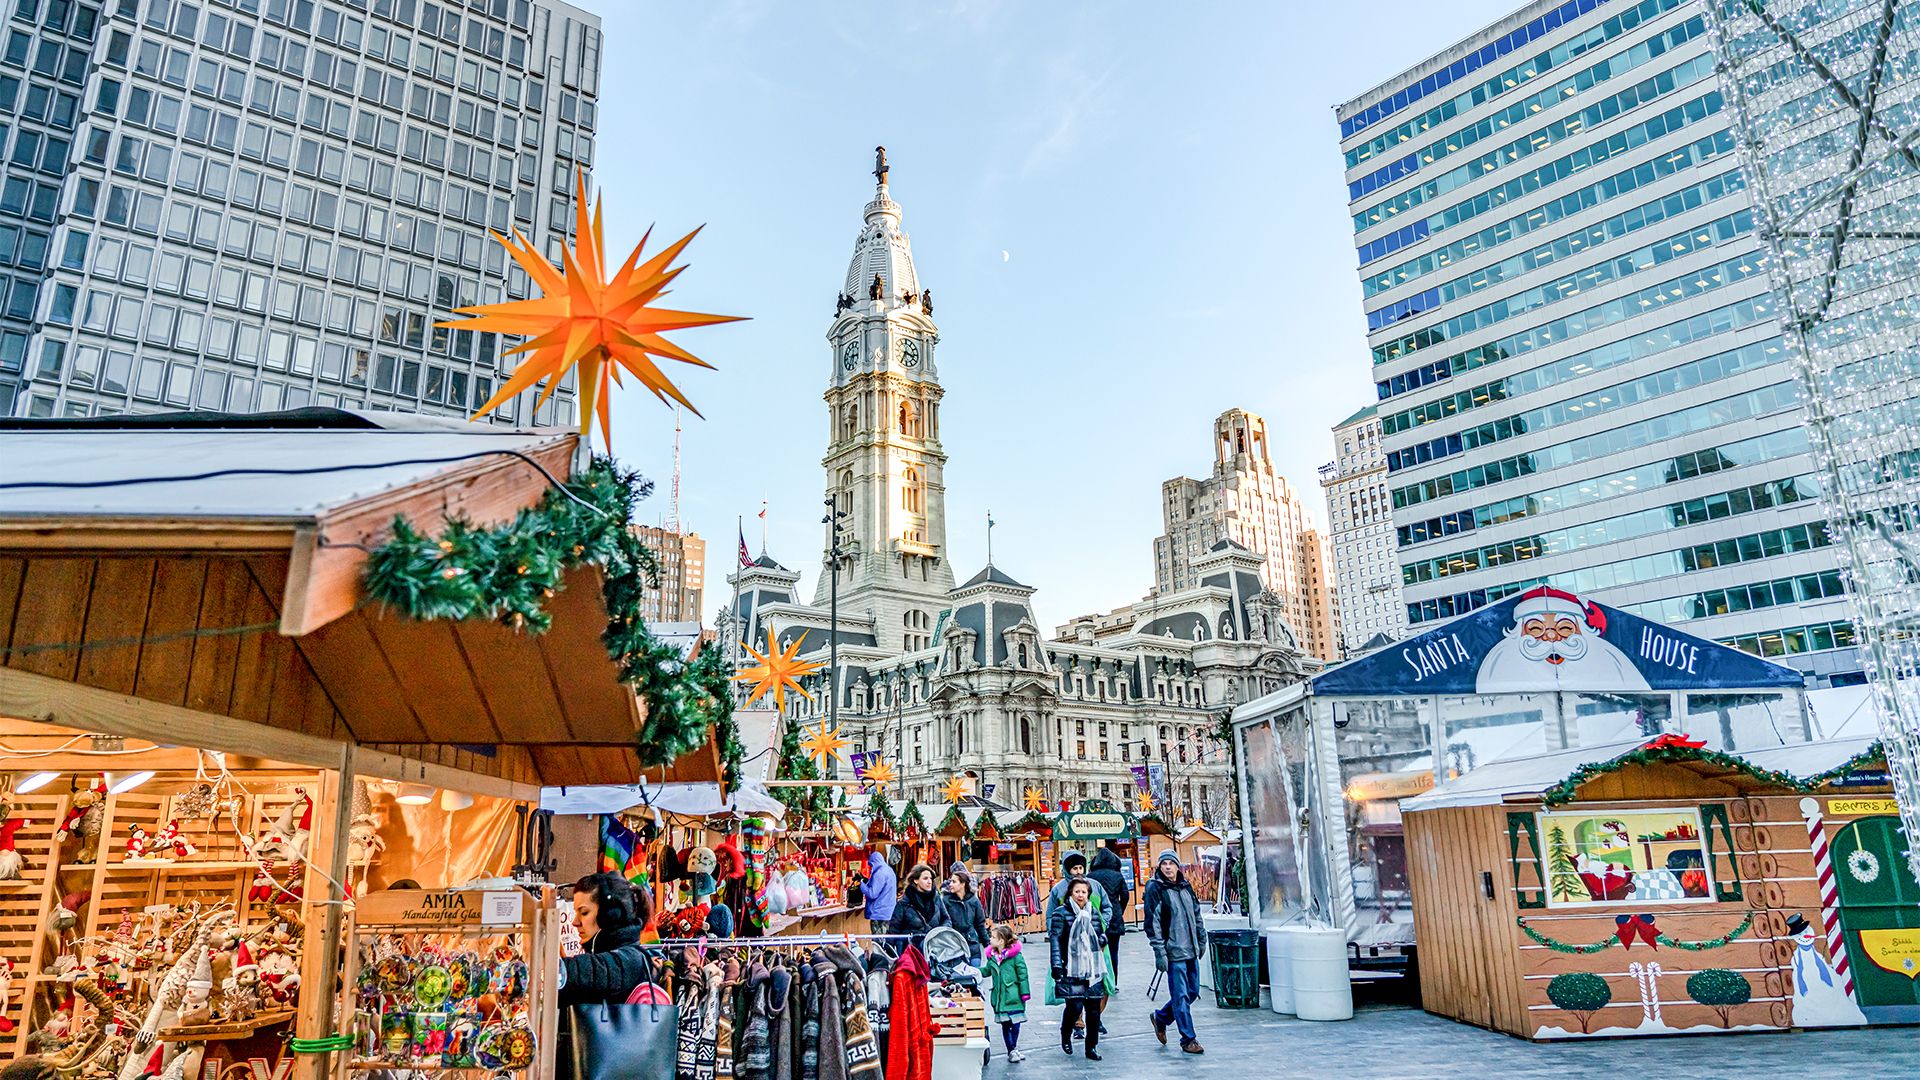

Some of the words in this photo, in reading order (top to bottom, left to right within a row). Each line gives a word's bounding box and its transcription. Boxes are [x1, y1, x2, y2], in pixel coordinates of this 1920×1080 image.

[1403, 632, 1470, 682] SANTA
[1639, 625, 1700, 675] HOUSE
[1834, 801, 1880, 812] SANTA'S
[421, 894, 466, 909] AMIA
[402, 908, 458, 922] Handcrafted
[460, 908, 482, 922] Glas
